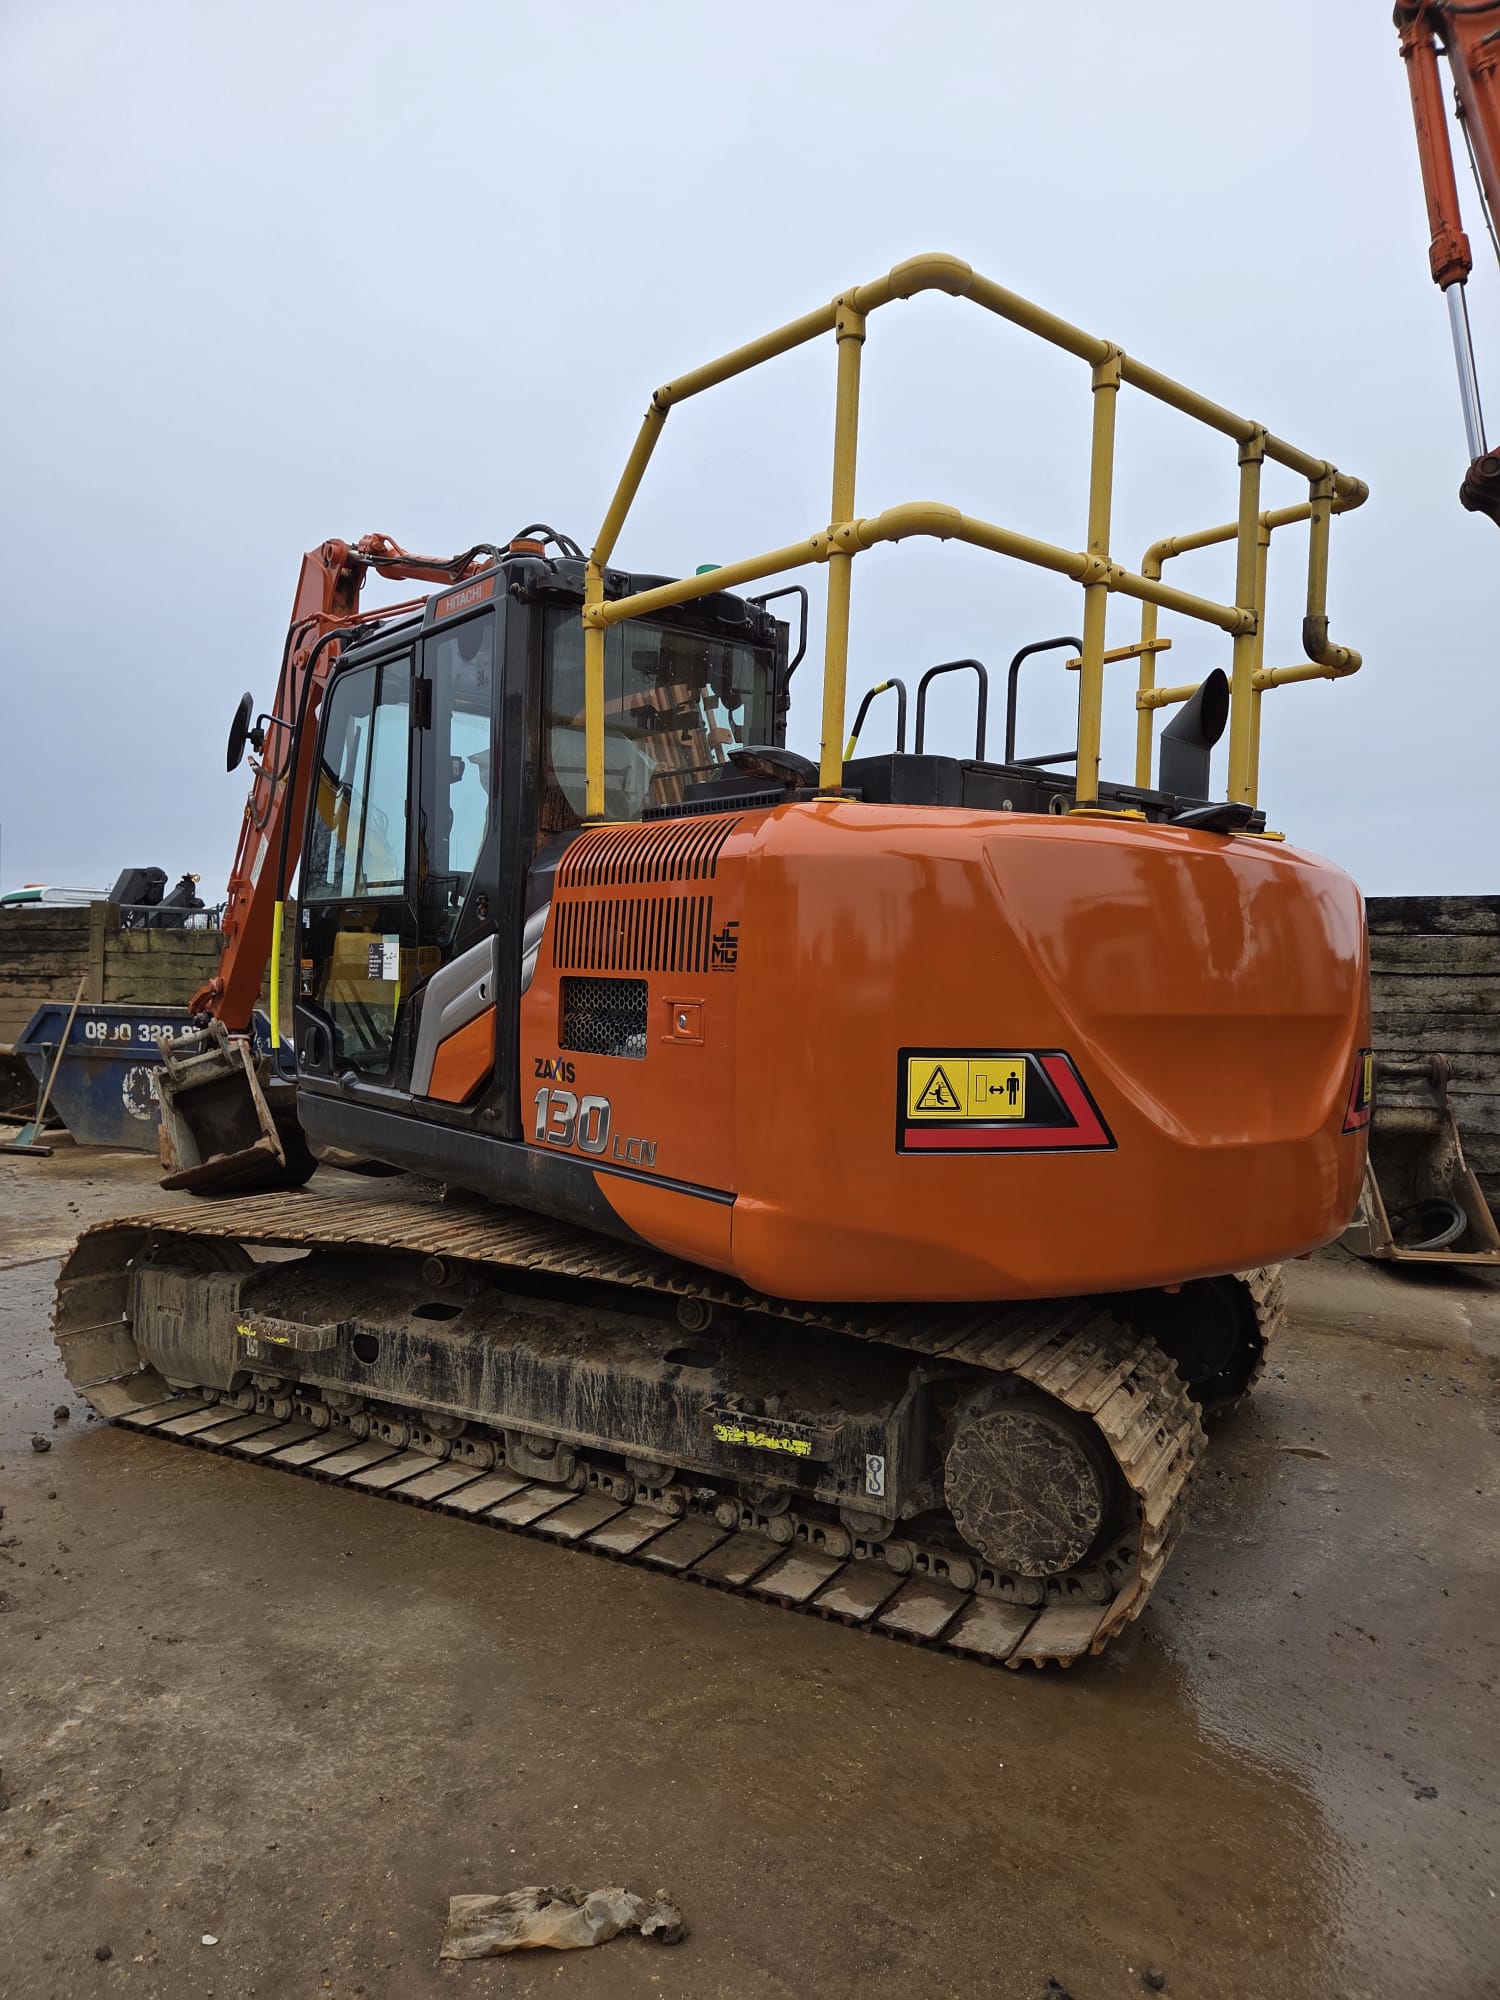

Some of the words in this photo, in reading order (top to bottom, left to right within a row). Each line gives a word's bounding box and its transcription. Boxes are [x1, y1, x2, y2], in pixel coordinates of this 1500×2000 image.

[446, 585, 482, 611] HITACHI
[138, 1024, 174, 1042] 328
[534, 1056, 576, 1083] ZAXIS
[533, 1087, 611, 1155] 130
[611, 1133, 658, 1168] LCN
